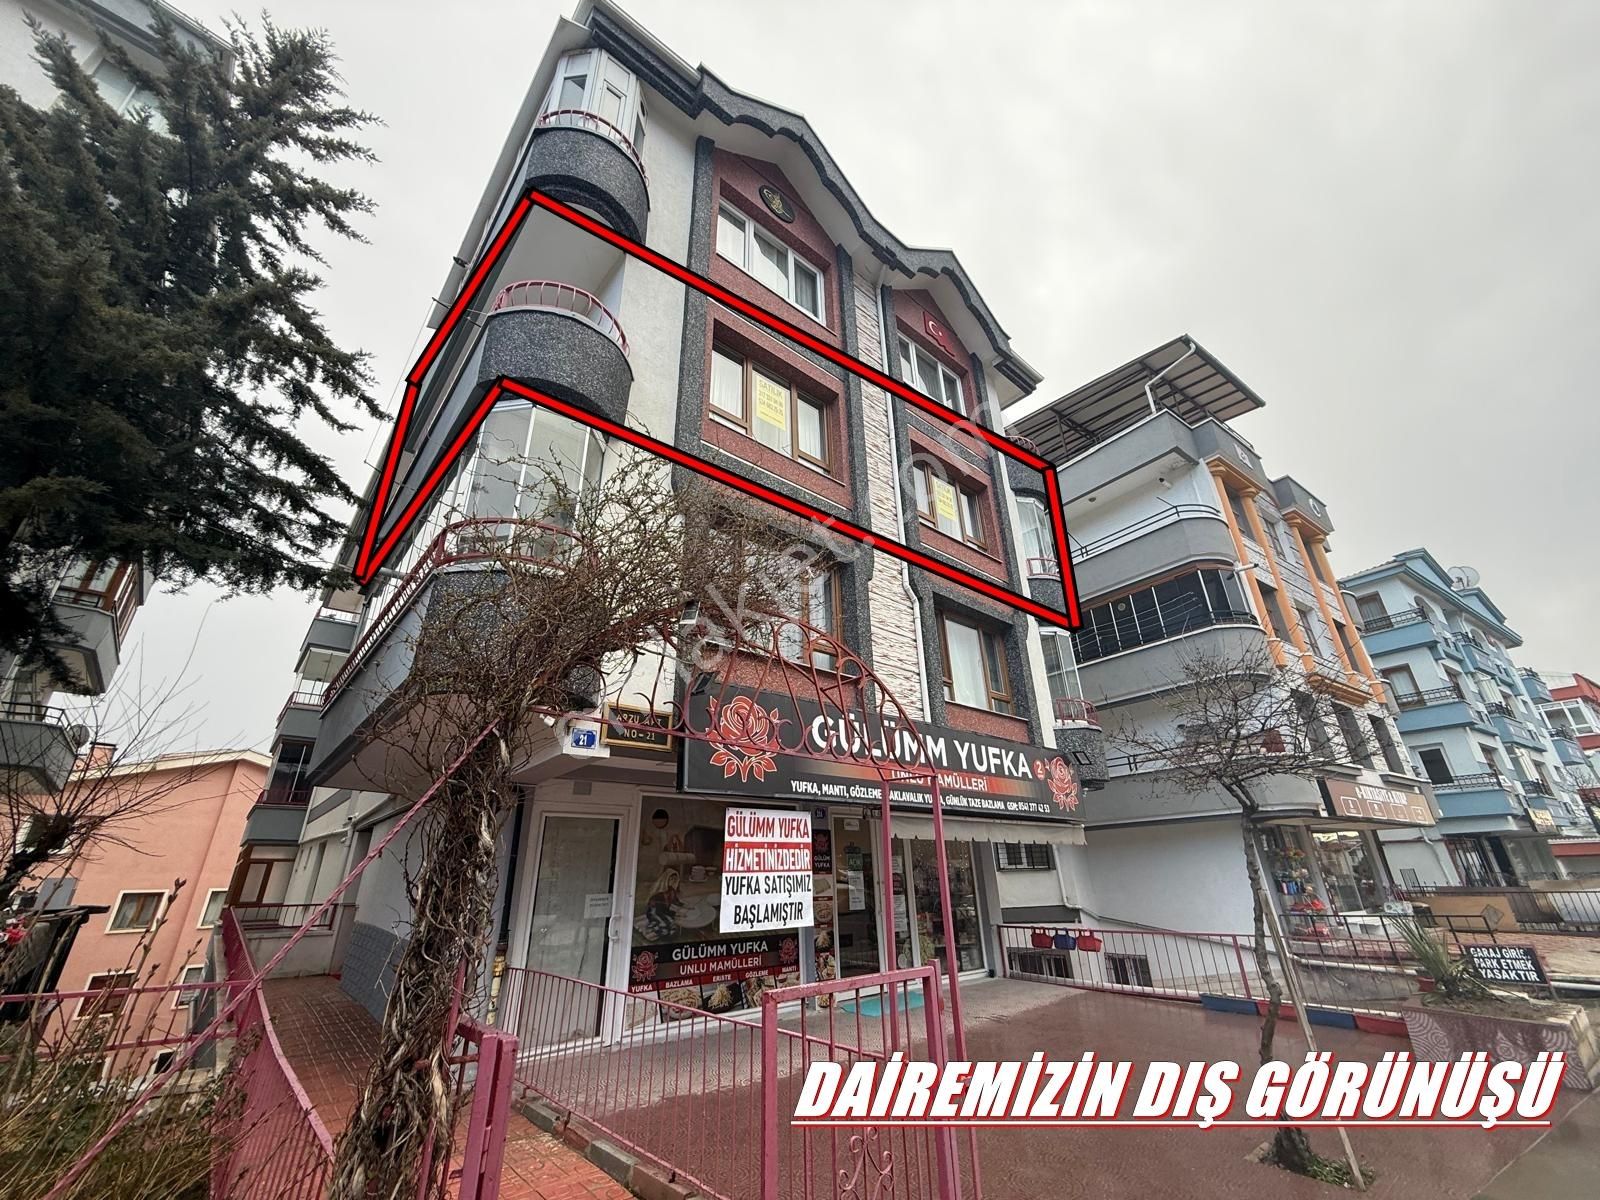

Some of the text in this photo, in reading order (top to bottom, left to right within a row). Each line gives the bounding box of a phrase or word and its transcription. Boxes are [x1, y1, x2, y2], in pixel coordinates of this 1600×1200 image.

[579, 734, 588, 746] 21
[811, 712, 1033, 780] GÜLÜMM YUFKA
[790, 780, 821, 796] YUFKA,
[821, 783, 849, 799] MANTI,
[885, 789, 924, 803] AKLAVALIK
[924, 793, 946, 807] YUA,
[945, 793, 969, 807] GÜNLÜK
[967, 797, 982, 808] TAZE
[727, 811, 809, 839] GÜLÜMM YUFKA
[725, 843, 811, 871] HİZMETİNİZDEDİR
[725, 874, 812, 898] YUFKA SATIŞIMIZ
[733, 901, 804, 929] BAŞLAMIŞTIR
[672, 940, 769, 961] GÜLÜMM YUFKA
[1470, 946, 1502, 959] GARAJ
[680, 954, 762, 976] UNLU MAMÜLLERİ
[745, 969, 769, 979] GÖZLEME
[1473, 957, 1536, 971] PARK ETMEK
[665, 978, 693, 989] BAZLAMA
[1478, 968, 1540, 982] YASAKTIR
[631, 983, 653, 993] YUFKA
